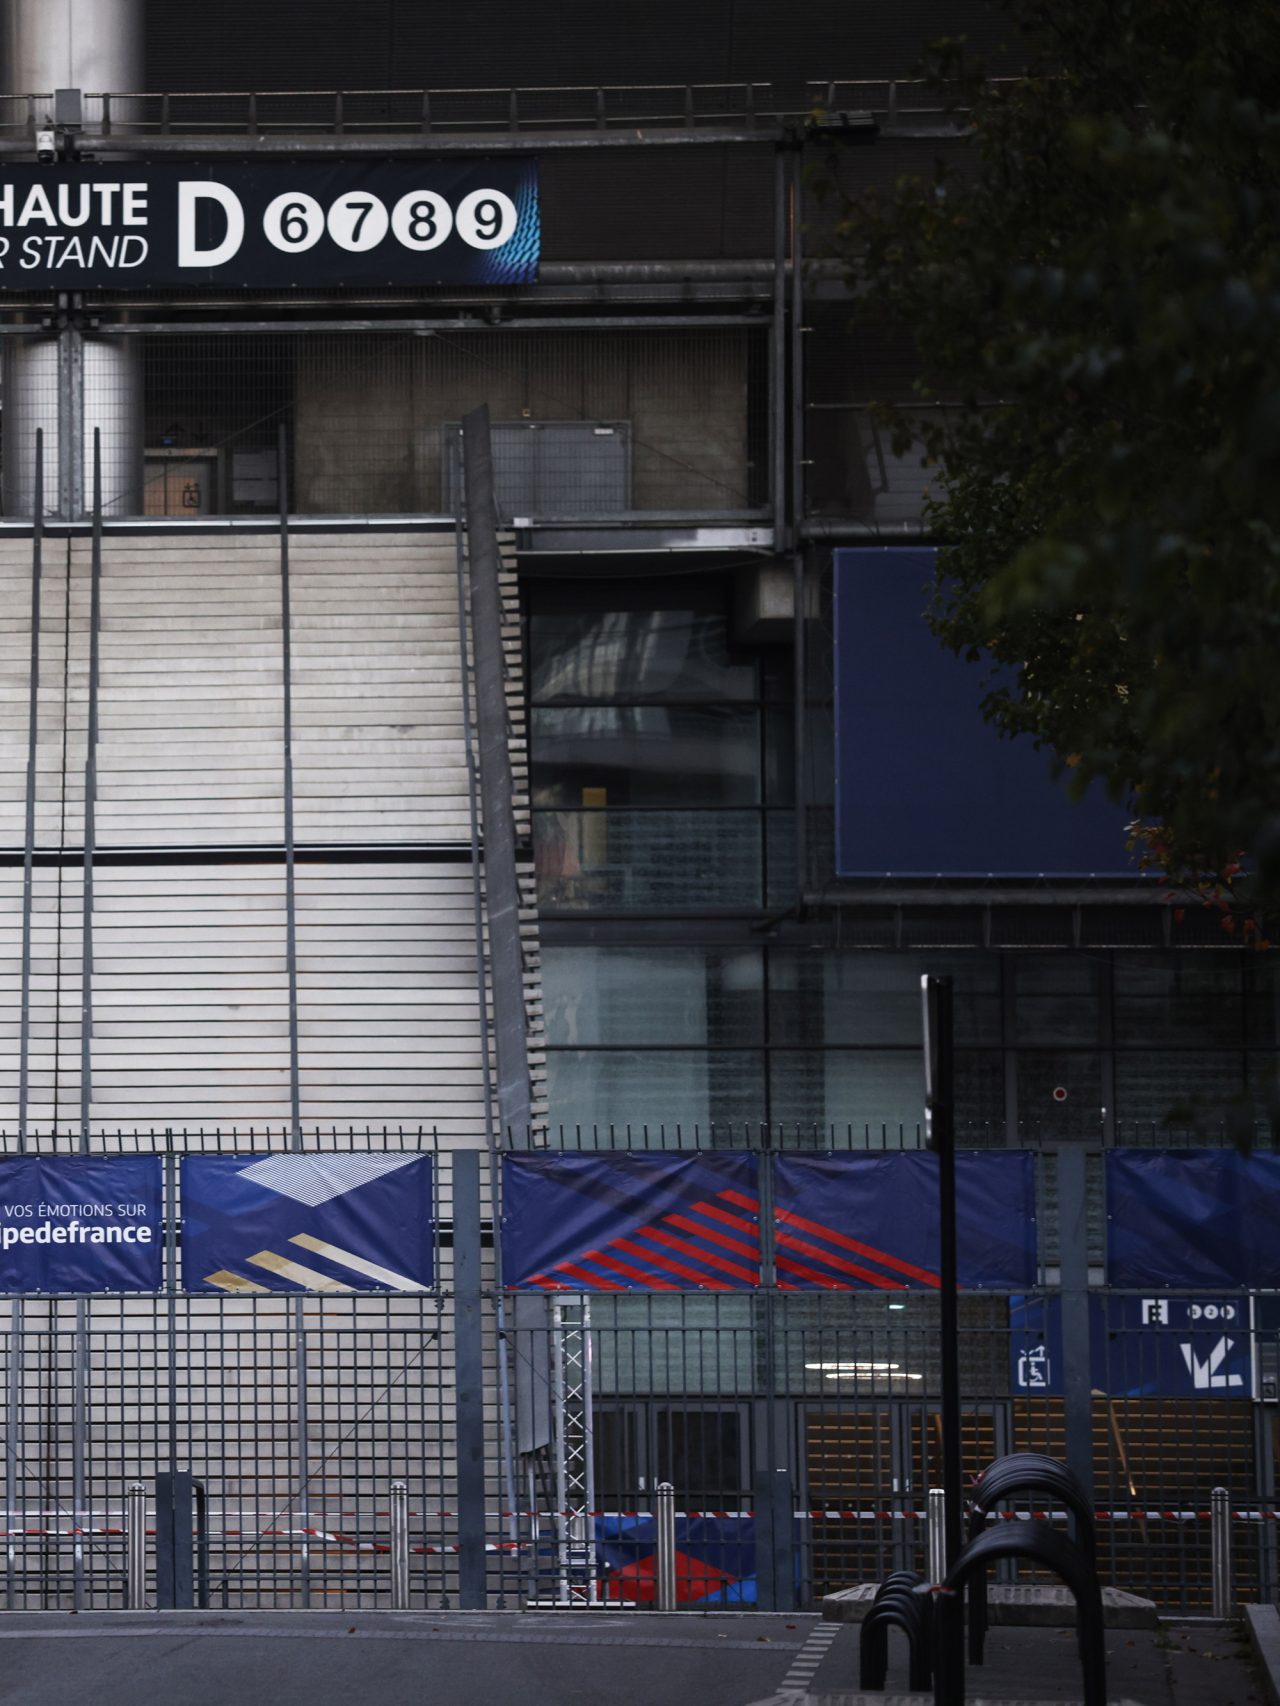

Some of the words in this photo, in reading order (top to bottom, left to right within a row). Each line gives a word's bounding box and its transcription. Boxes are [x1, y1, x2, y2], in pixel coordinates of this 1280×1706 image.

[177, 180, 245, 268] D
[280, 202, 309, 244] 6
[345, 202, 374, 243] 7
[408, 200, 437, 243] 8
[474, 199, 503, 241] 9
[19, 235, 150, 269] STAND
[4, 1204, 34, 1218] VOS
[37, 1200, 114, 1218] ÉMOTIONS
[117, 1203, 147, 1217] SUR
